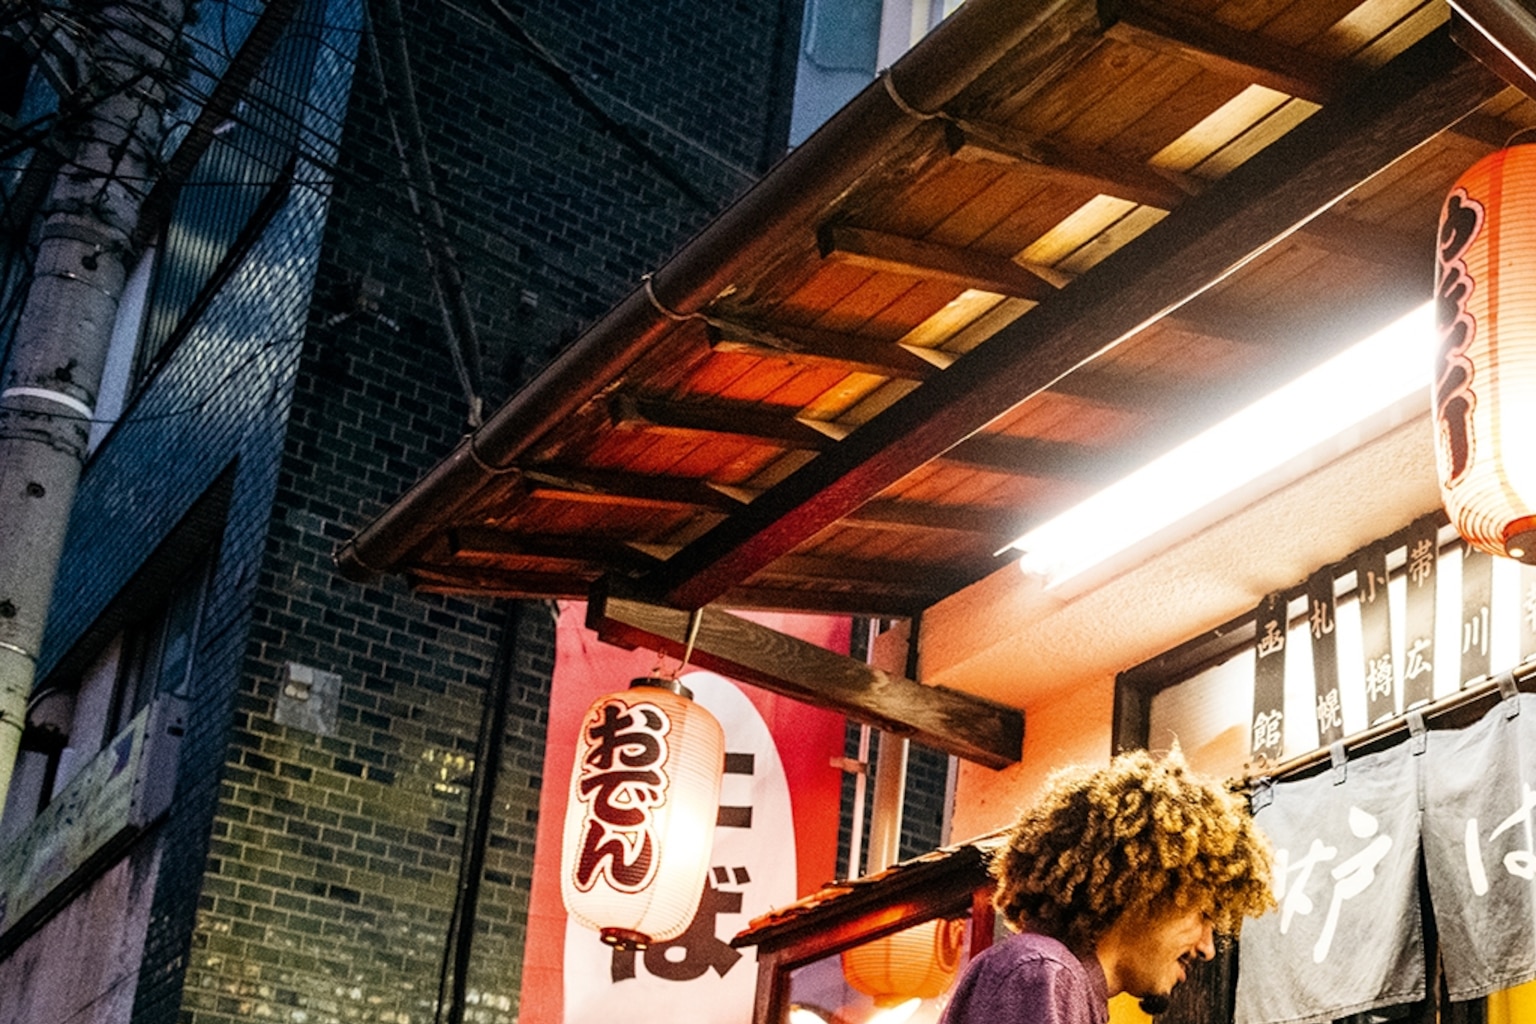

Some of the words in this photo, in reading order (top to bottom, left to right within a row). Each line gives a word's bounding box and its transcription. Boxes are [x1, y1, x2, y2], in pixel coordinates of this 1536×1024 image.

[1311, 599, 1342, 734] 札幌
[1359, 570, 1394, 703] 小樽
[1404, 540, 1435, 681] 帯広
[1252, 619, 1286, 752] 函館
[576, 703, 664, 888] おでん
